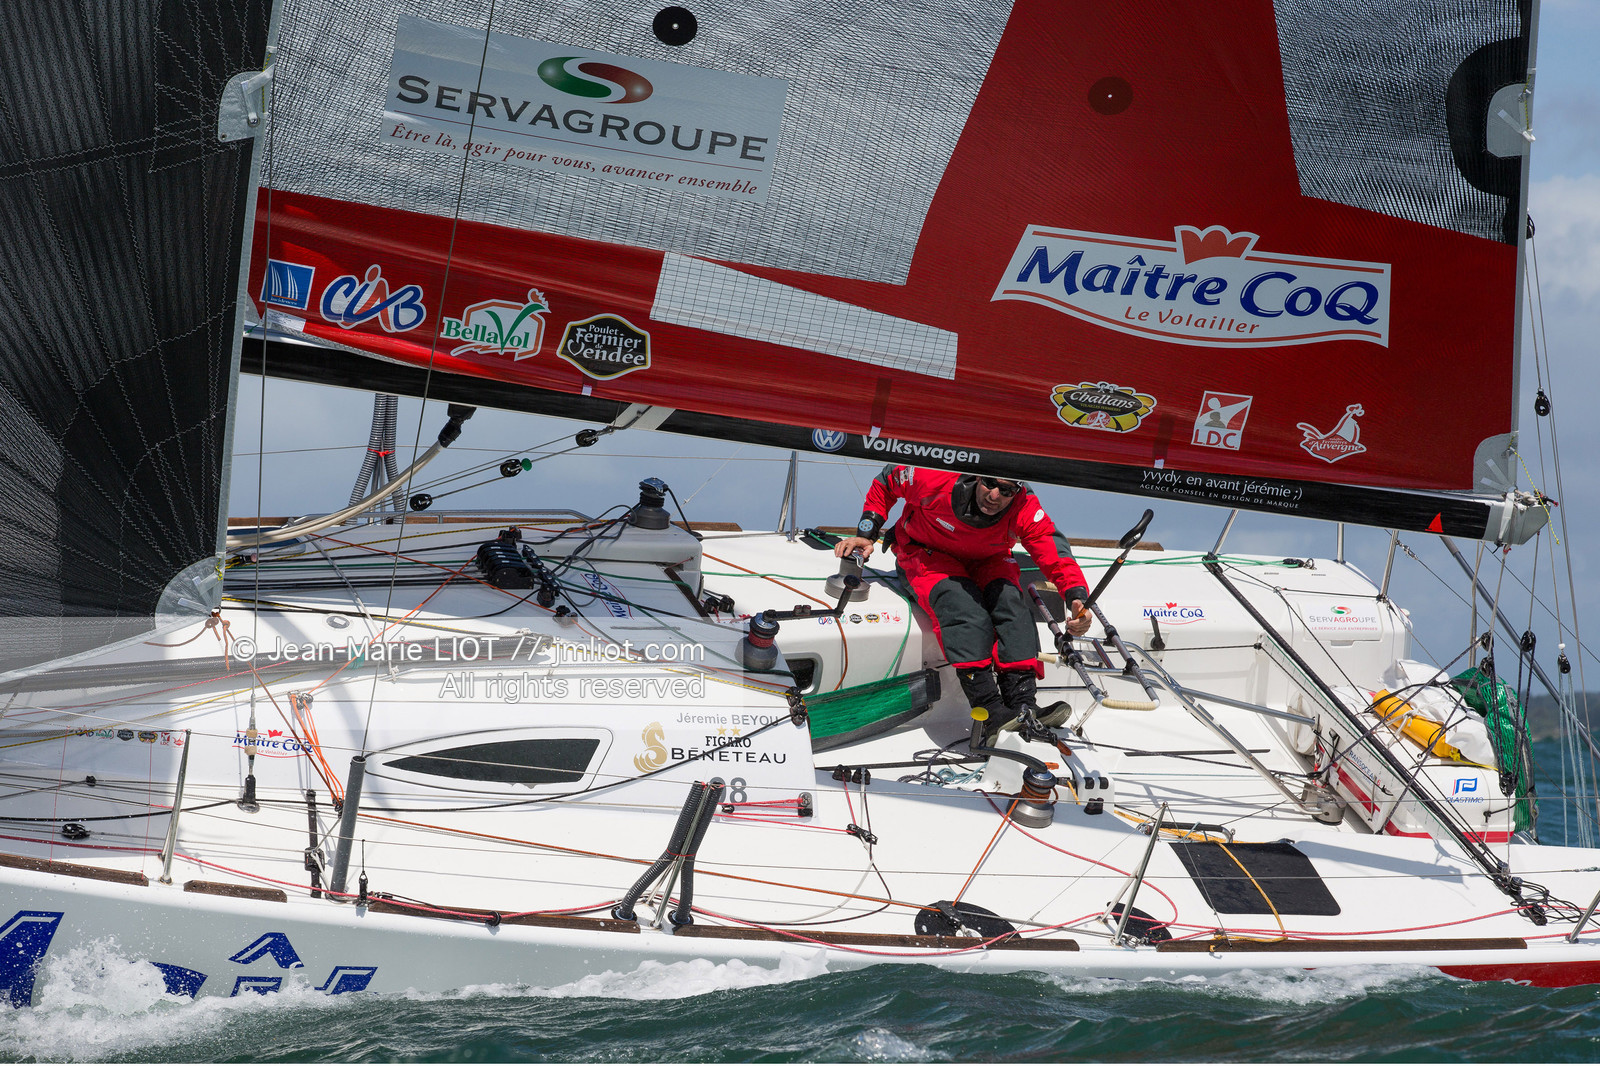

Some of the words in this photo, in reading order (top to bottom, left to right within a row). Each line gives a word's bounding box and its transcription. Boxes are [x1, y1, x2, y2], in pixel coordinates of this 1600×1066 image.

[390, 123, 431, 144] Être
[435, 132, 456, 150] là,
[463, 142, 501, 157] agir
[502, 147, 547, 162] pour
[551, 156, 596, 172] vous,
[602, 164, 674, 182] avancer
[678, 179, 758, 195] ensemble
[1016, 245, 1228, 306] Maître
[1240, 271, 1379, 325] CoQ
[443, 303, 545, 352] BellaVol
[589, 324, 619, 335] Poulet
[1124, 306, 1149, 321] Le
[1158, 309, 1260, 334] Volailler
[576, 327, 642, 349] Fermier
[567, 339, 645, 365] Vendée
[1070, 391, 1136, 409] Challans
[862, 434, 980, 464] Volkswagen
[1309, 441, 1361, 452] d'Auvergne
[1139, 483, 1170, 492] AGENCE
[1172, 487, 1205, 497] CONSEIL
[1221, 494, 1250, 502] DESIGN
[1266, 500, 1299, 509] MARQUE
[1142, 470, 1182, 486] yvydy.
[1186, 476, 1202, 486] en
[1205, 479, 1240, 491] avant
[1241, 480, 1291, 497] jérémie
[1143, 608, 1177, 618] Maître
[1180, 607, 1204, 618] CoQ
[731, 714, 779, 727] BEYOU
[705, 735, 752, 748] FIGARO
